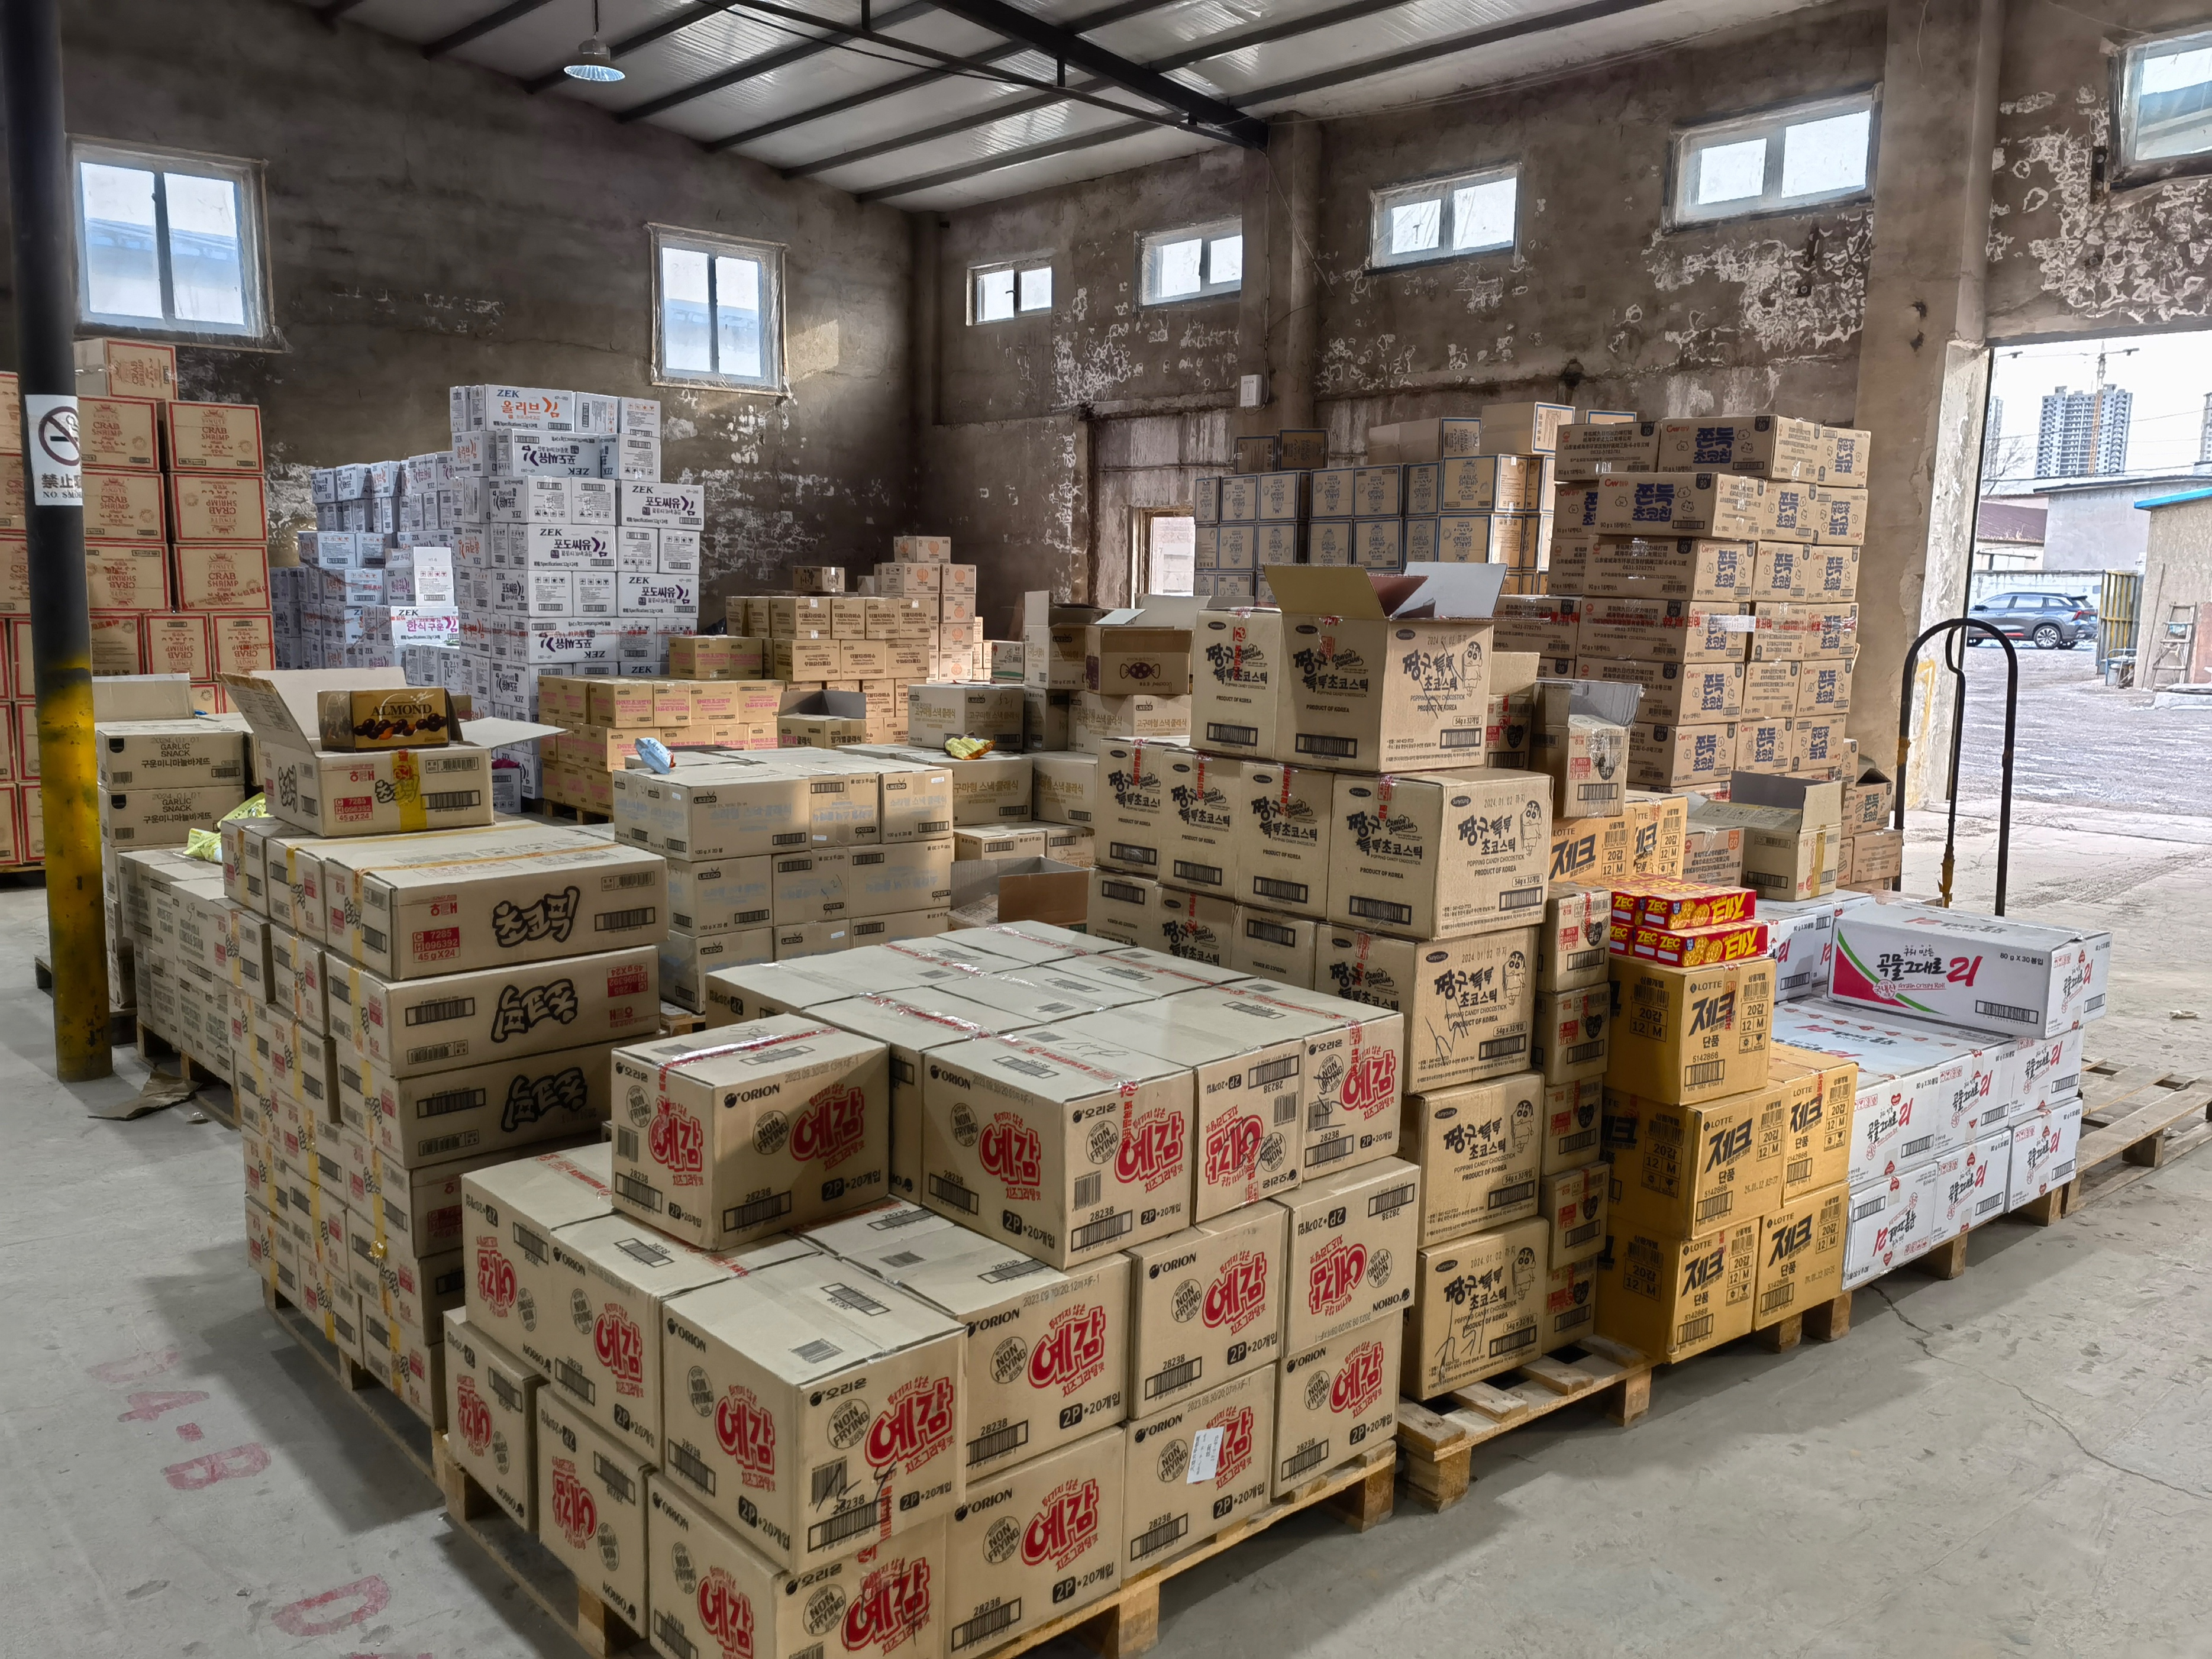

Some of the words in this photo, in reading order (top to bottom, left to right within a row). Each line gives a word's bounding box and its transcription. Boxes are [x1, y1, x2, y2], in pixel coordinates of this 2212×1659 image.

[497, 389, 519, 398] ZEK
[501, 402, 541, 414] 올리브
[554, 539, 591, 550] 포도씨유
[1424, 677, 1458, 692] 초코스틱
[372, 703, 432, 716] ALMOND
[1481, 837, 1516, 855] 초코스틱
[1607, 850, 1623, 860] 20갑
[1551, 834, 1596, 880] 제크
[1603, 865, 1613, 874] 12
[1616, 863, 1623, 872] M
[1614, 895, 1634, 908] ZEC
[1647, 899, 1667, 912] ZEC
[430, 929, 451, 938] 7285
[1637, 931, 1658, 943] ZEC
[1659, 935, 1681, 948] ZEC
[425, 938, 458, 950] 096392
[1877, 954, 1946, 981] 곡물그대로
[1698, 980, 1722, 991] LOTTE
[1459, 988, 1497, 1007] 초코스틱
[1688, 990, 1736, 1037] 제크
[1747, 1004, 1764, 1016] 20갑
[1742, 1021, 1751, 1031] 12
[1756, 1018, 1764, 1028] M
[1317, 1039, 1343, 1052] 오리온
[1703, 1035, 1720, 1048] 단품
[1693, 1051, 1719, 1062] 5142866
[625, 1066, 648, 1082] 오리온
[941, 1071, 971, 1090] ORION
[1340, 1049, 1397, 1111] 예감
[741, 1083, 780, 1102] ORION
[1263, 1080, 1283, 1093] 28238
[1793, 1086, 1812, 1096] LOTTE
[631, 1095, 644, 1109] NON
[1085, 1102, 1116, 1119] 오리온
[1832, 1106, 1845, 1115] 20갑
[790, 1086, 864, 1161] 예감
[1711, 1115, 1733, 1128] LOTTE
[1790, 1095, 1823, 1136] 제크
[1320, 1129, 1339, 1142] 28238
[1764, 1129, 1779, 1143] 20갑
[979, 1124, 1041, 1186] 예감
[1115, 1112, 1184, 1183] 예감
[1469, 1138, 1506, 1161] 초코스틱
[1704, 1118, 1753, 1174] 제크
[1454, 1164, 1472, 1173] POPPING
[1474, 1160, 1488, 1168] CANDY
[1489, 1153, 1516, 1164] CHOCOSTICK
[1262, 1171, 1290, 1189] 오리온
[1462, 1171, 1484, 1182] PRODUCT
[1491, 1164, 1507, 1173] KOREA
[1719, 1167, 1735, 1184] 단품
[1090, 1206, 1115, 1222] 28238
[1774, 1212, 1794, 1225] LOTTE
[1690, 1239, 1712, 1253] LOTTE
[1768, 1213, 1813, 1267] 제크
[563, 1254, 586, 1276] ORION
[1162, 1253, 1197, 1273] ORION
[1681, 1248, 1724, 1297] 제크
[1202, 1252, 1267, 1328] 예감
[1470, 1286, 1507, 1311] 초코스틱
[980, 1308, 1021, 1331] ORION
[594, 1313, 642, 1383] 예감
[677, 1325, 706, 1353] ORION
[1028, 1306, 1106, 1388] 예감
[1163, 1354, 1186, 1370] 28238
[826, 1379, 867, 1399] 오리온
[833, 1411, 868, 1449] FRYING
[865, 1377, 954, 1467] 예감
[980, 1419, 1008, 1436] 28238
[1145, 1413, 1183, 1436] ORION
[715, 1396, 775, 1475] 예감
[1296, 1438, 1316, 1454] 28238
[1162, 1446, 1181, 1467] NON
[968, 1488, 1013, 1513] ORION
[1213, 1494, 1233, 1519] 2P
[1021, 1479, 1100, 1566] 예감
[1149, 1513, 1171, 1529] 28238
[974, 1597, 1000, 1616] 28238
[697, 1575, 754, 1658] 예감
